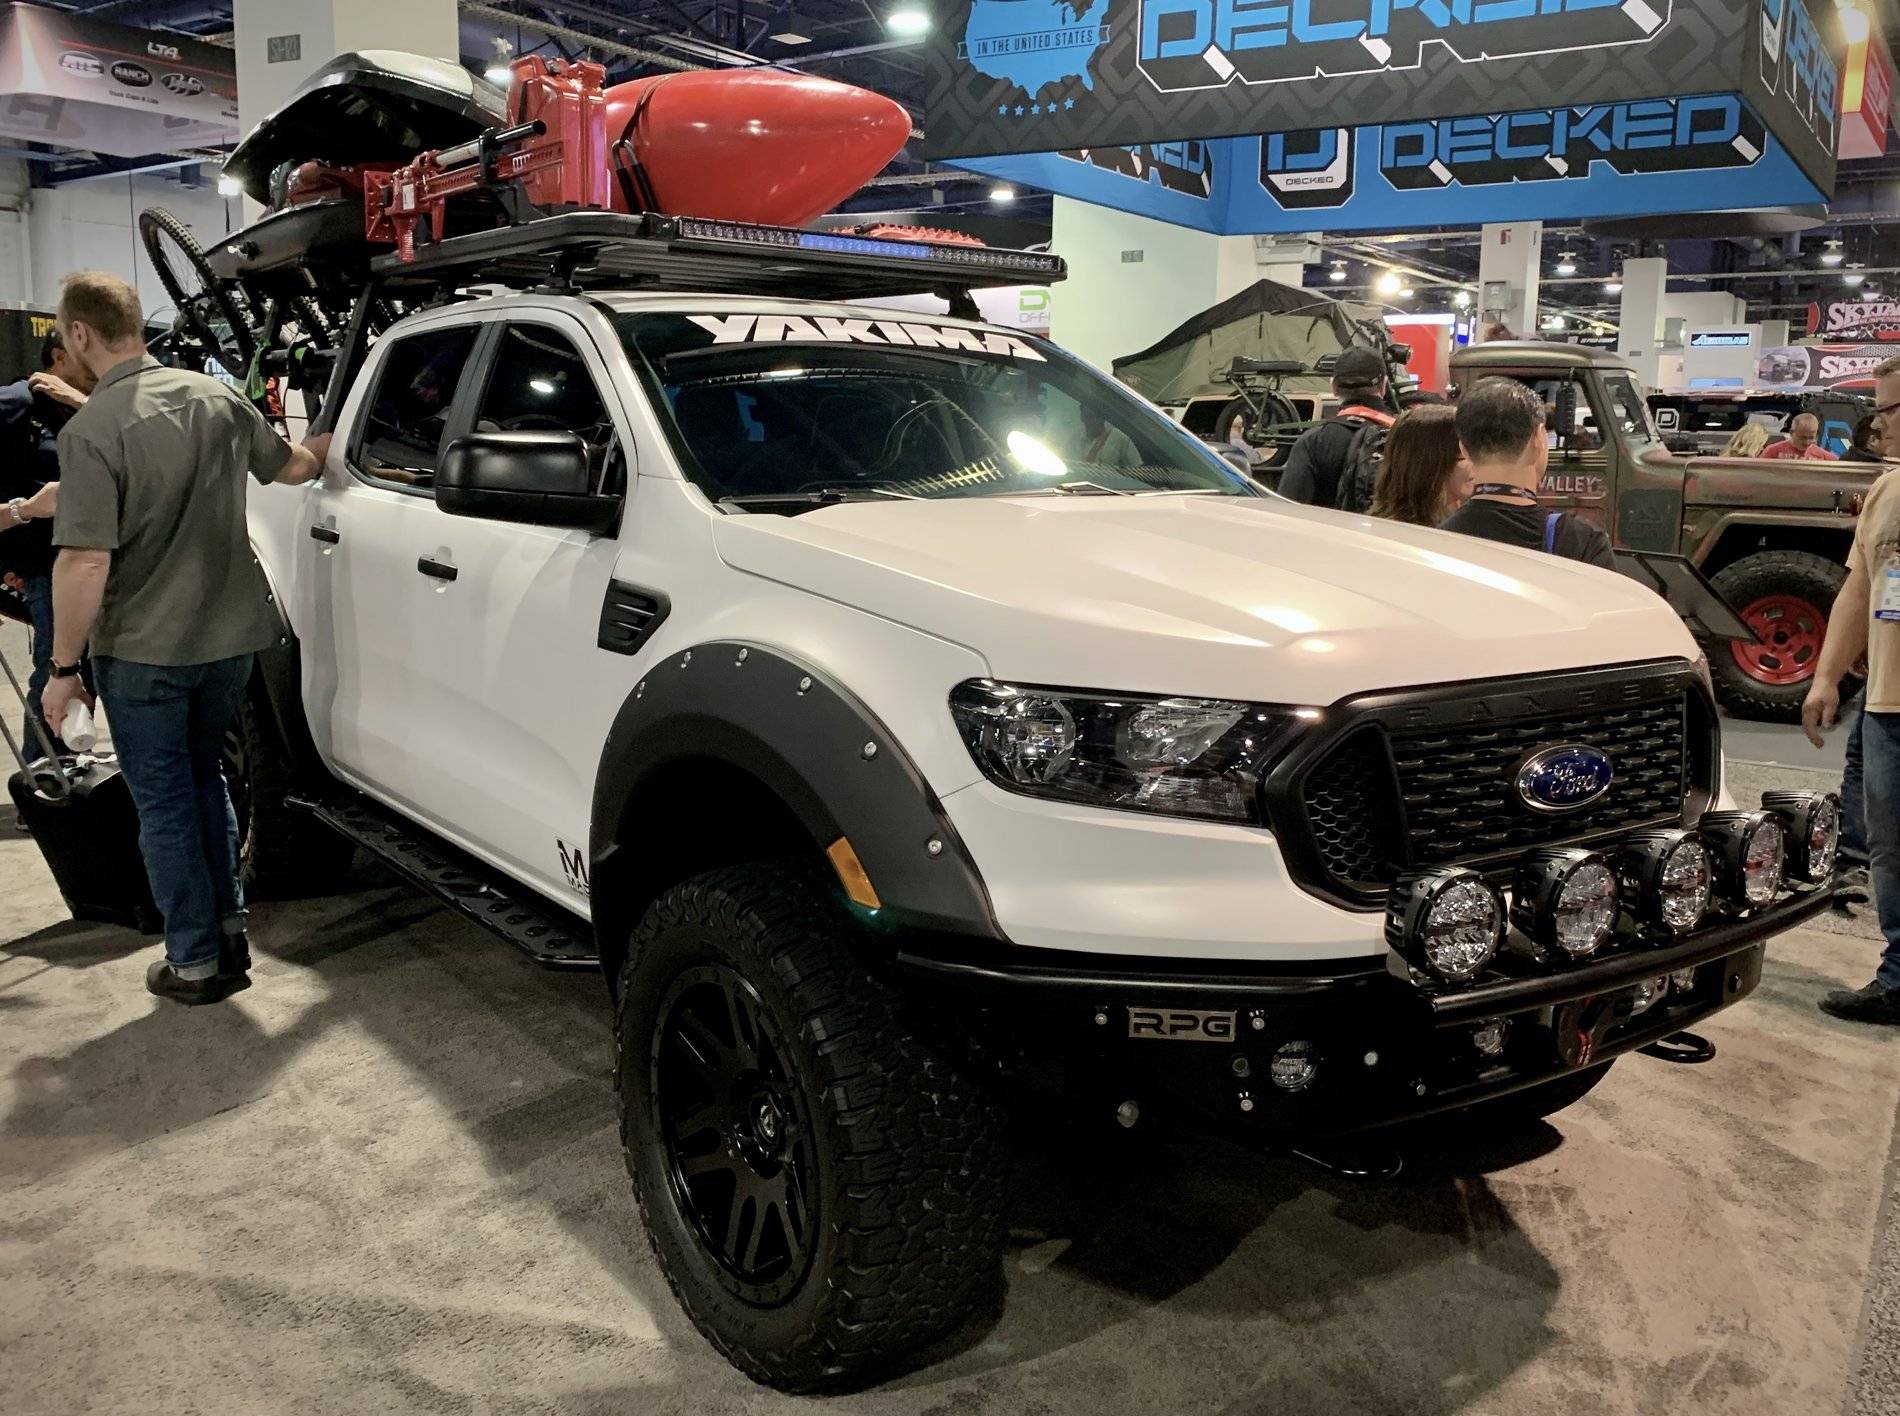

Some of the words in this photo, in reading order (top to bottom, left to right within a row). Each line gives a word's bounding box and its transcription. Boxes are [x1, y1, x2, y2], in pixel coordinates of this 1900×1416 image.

[977, 41, 988, 54] IN
[993, 39, 1009, 52] THE
[1014, 34, 1050, 51] UNITED
[1055, 29, 1093, 46] STATES
[114, 66, 150, 82] RANCH
[1382, 95, 1741, 168] DECKED
[1285, 175, 1334, 186] DECKED
[686, 314, 1048, 362] YAKIMA
[1549, 762, 1599, 799] Ford
[1132, 1011, 1232, 1039] RPG
